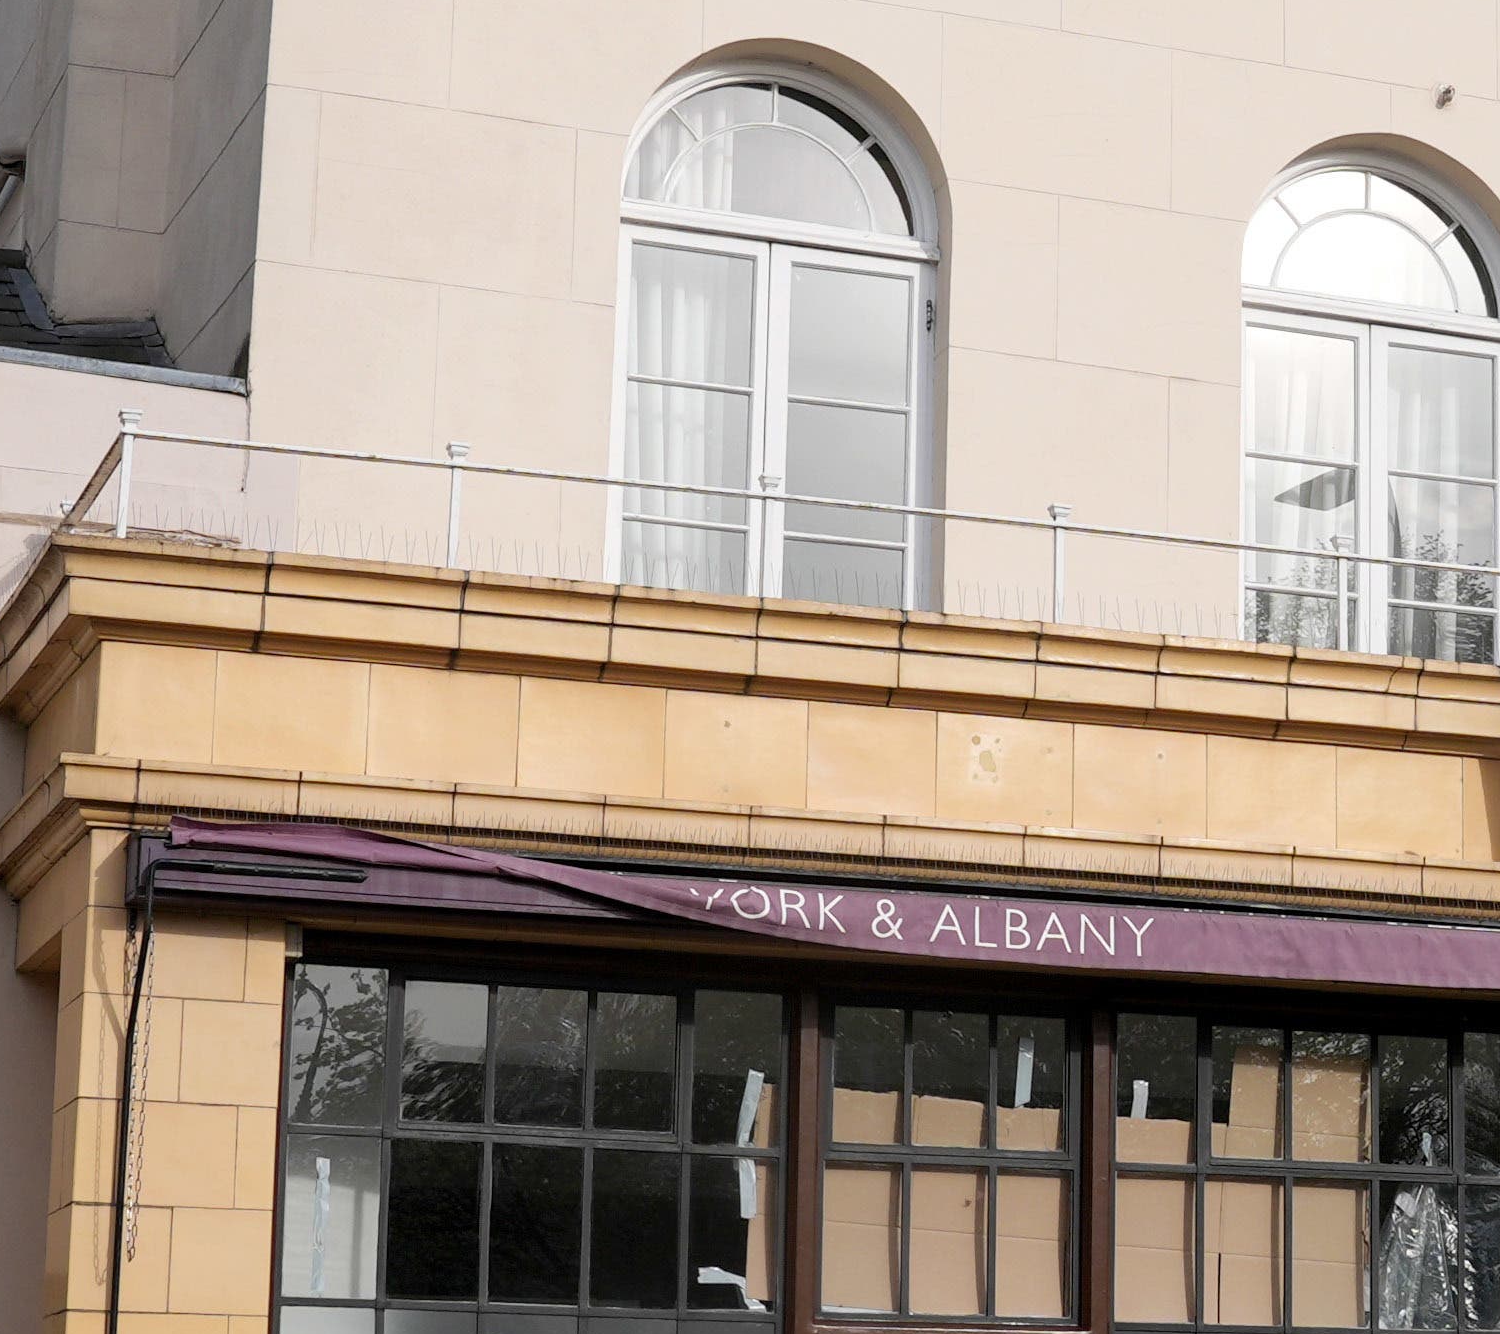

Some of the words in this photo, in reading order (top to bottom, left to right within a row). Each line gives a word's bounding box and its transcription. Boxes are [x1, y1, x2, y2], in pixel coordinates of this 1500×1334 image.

[689, 885, 846, 934] YORK
[870, 898, 905, 941] &
[928, 903, 1156, 958] ALBANY
